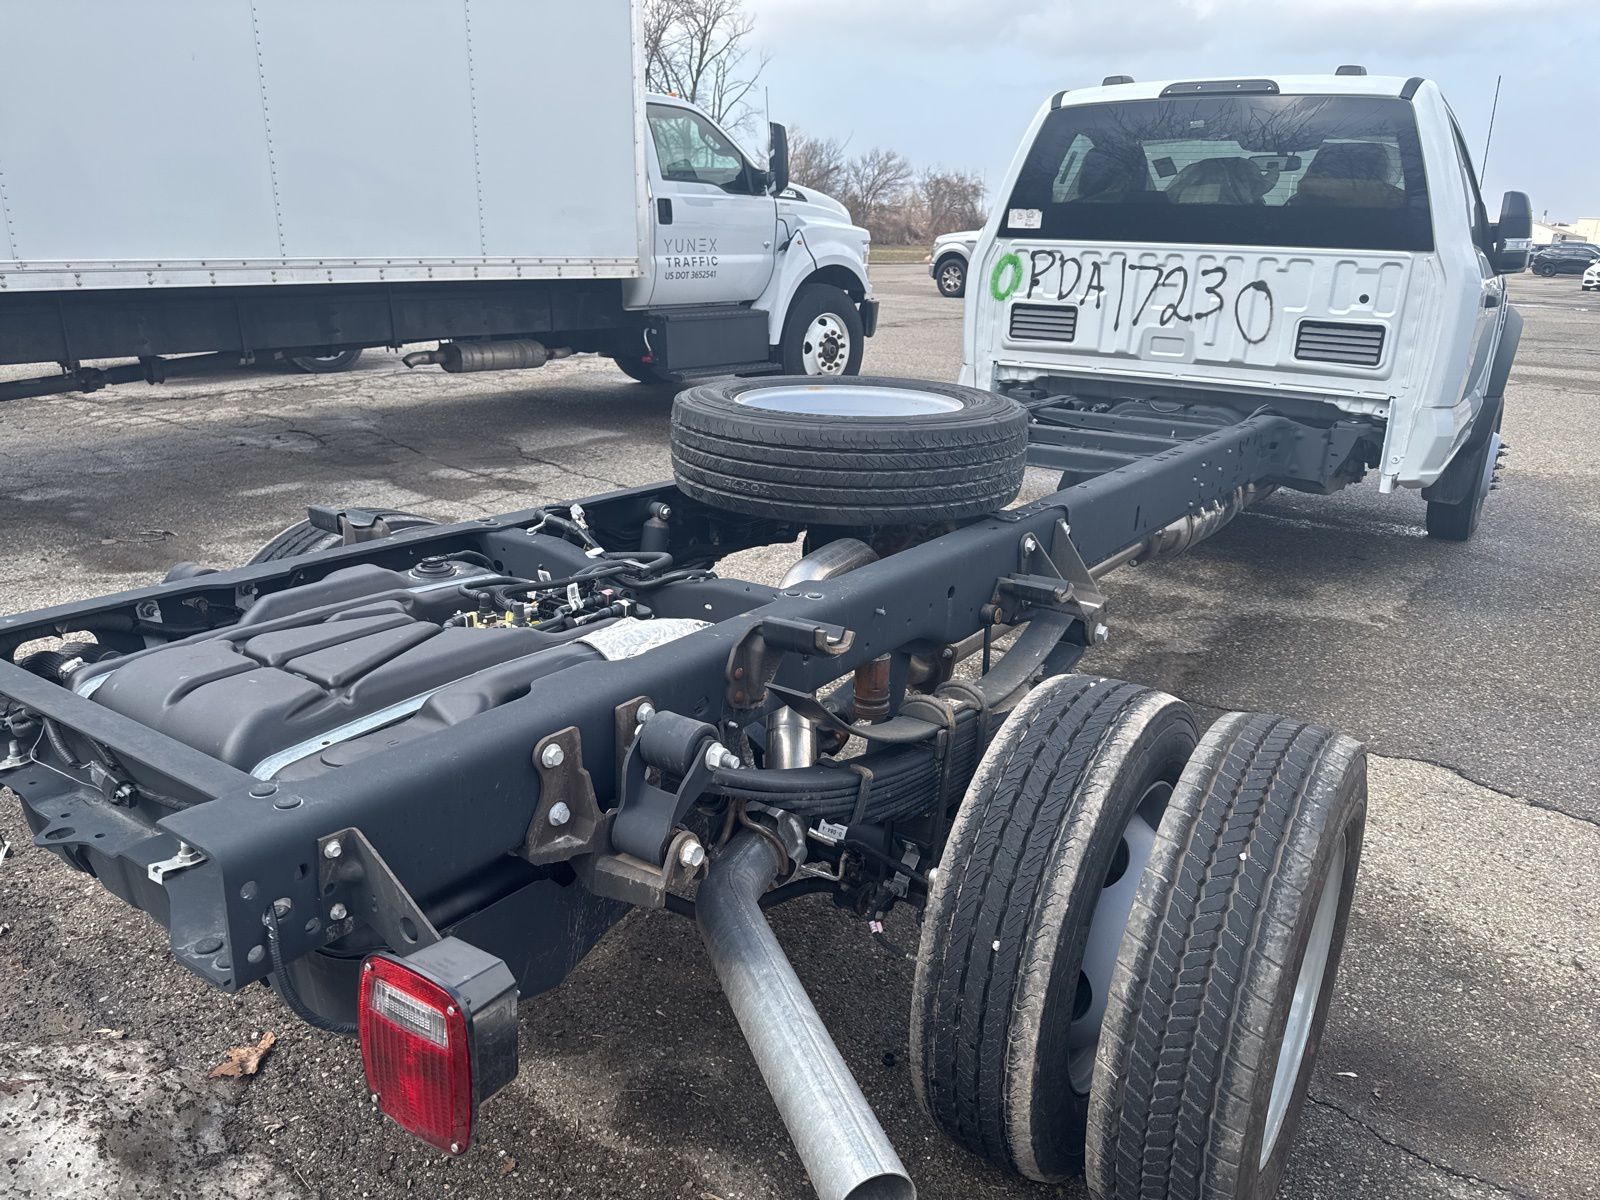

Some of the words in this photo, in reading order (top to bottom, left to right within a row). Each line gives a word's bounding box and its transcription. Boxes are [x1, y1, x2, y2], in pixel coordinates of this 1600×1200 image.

[664, 238, 717, 253] YUNEX
[665, 256, 718, 268] TRAFFIC
[665, 271, 674, 280] US
[675, 271, 689, 280] DOT
